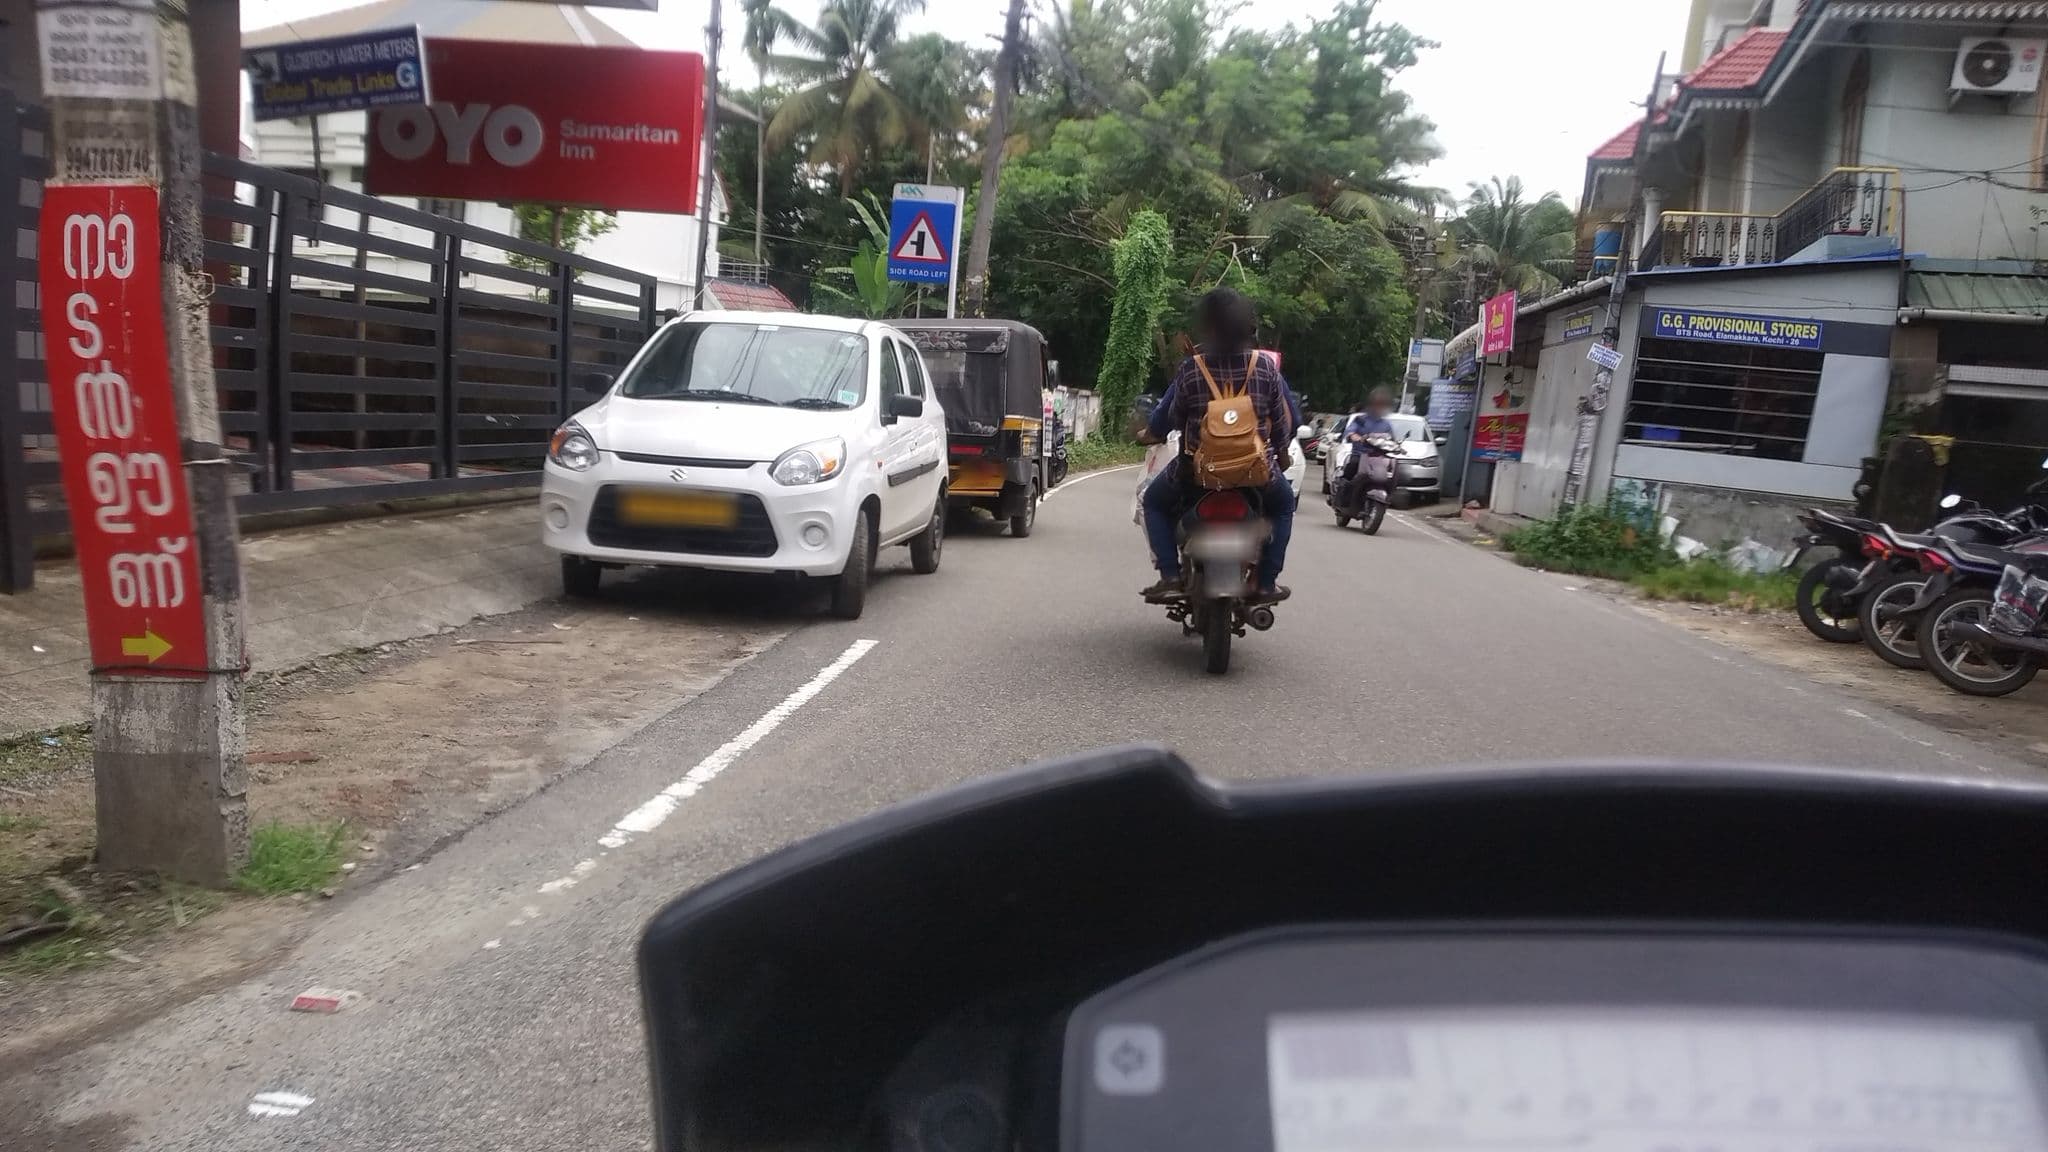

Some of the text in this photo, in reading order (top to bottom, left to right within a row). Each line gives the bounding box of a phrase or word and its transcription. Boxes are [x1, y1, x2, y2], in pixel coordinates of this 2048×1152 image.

[335, 43, 372, 65] WATER
[373, 37, 416, 61] METERS
[310, 75, 352, 96] Trade
[356, 70, 396, 92] Links
[377, 101, 543, 167] OYO
[559, 119, 679, 144] Samaritan
[559, 139, 595, 160] Inn
[889, 268, 948, 278] SIDE ROAD LEFT
[1661, 314, 1818, 340] G.G. PROVISIONAL STORES
[1693, 330, 1714, 339] Road,
[1762, 336, 1785, 345] Kochi
